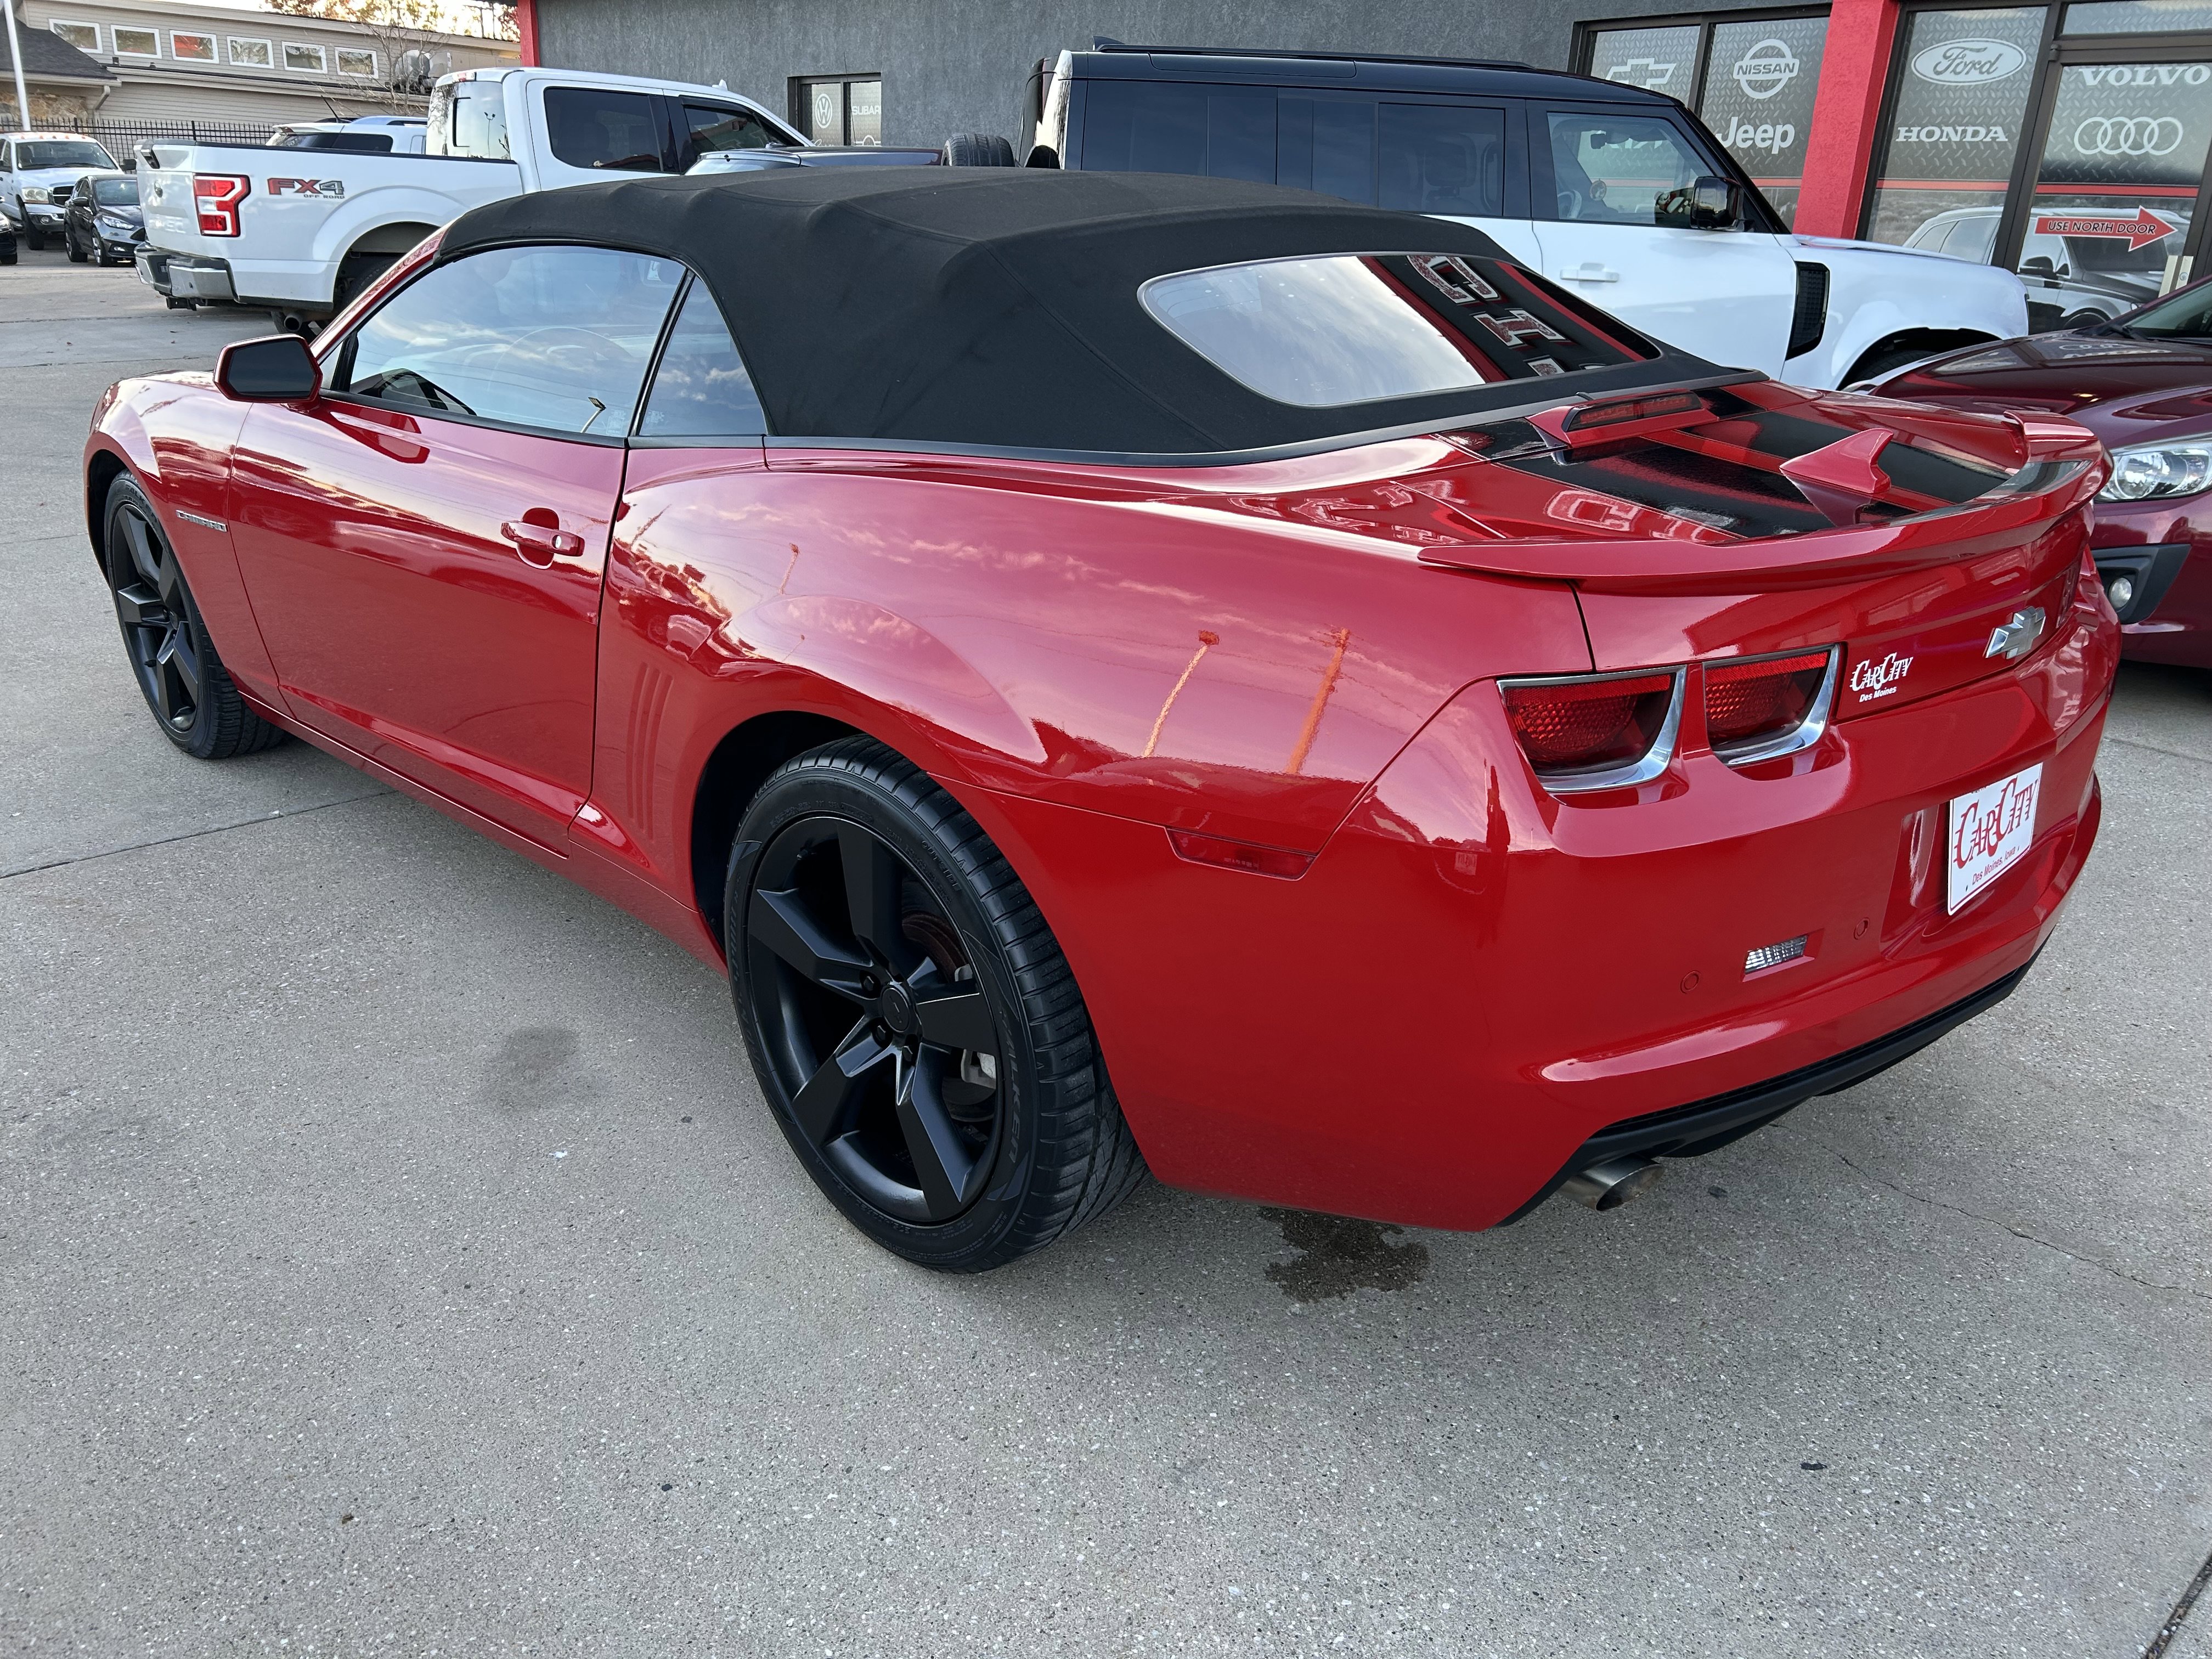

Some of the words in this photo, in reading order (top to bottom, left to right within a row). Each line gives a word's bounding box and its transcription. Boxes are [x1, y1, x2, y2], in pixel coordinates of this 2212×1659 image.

[1737, 62, 1795, 75] NISSAN
[1933, 46, 2004, 76] Ford
[2078, 65, 2211, 86] VOLVO
[851, 105, 881, 115] SUBAR
[1715, 116, 1795, 154] Jeep
[1895, 126, 2008, 142] HONDA
[267, 178, 345, 195] FX4
[2049, 221, 2069, 231] USE
[2072, 222, 2114, 233] NORTH
[2117, 223, 2157, 234] DOOR
[1859, 693, 1873, 703] Des
[1873, 686, 1897, 699] Moines
[1972, 869, 1983, 885] Des
[2004, 846, 2016, 862] Iowa
